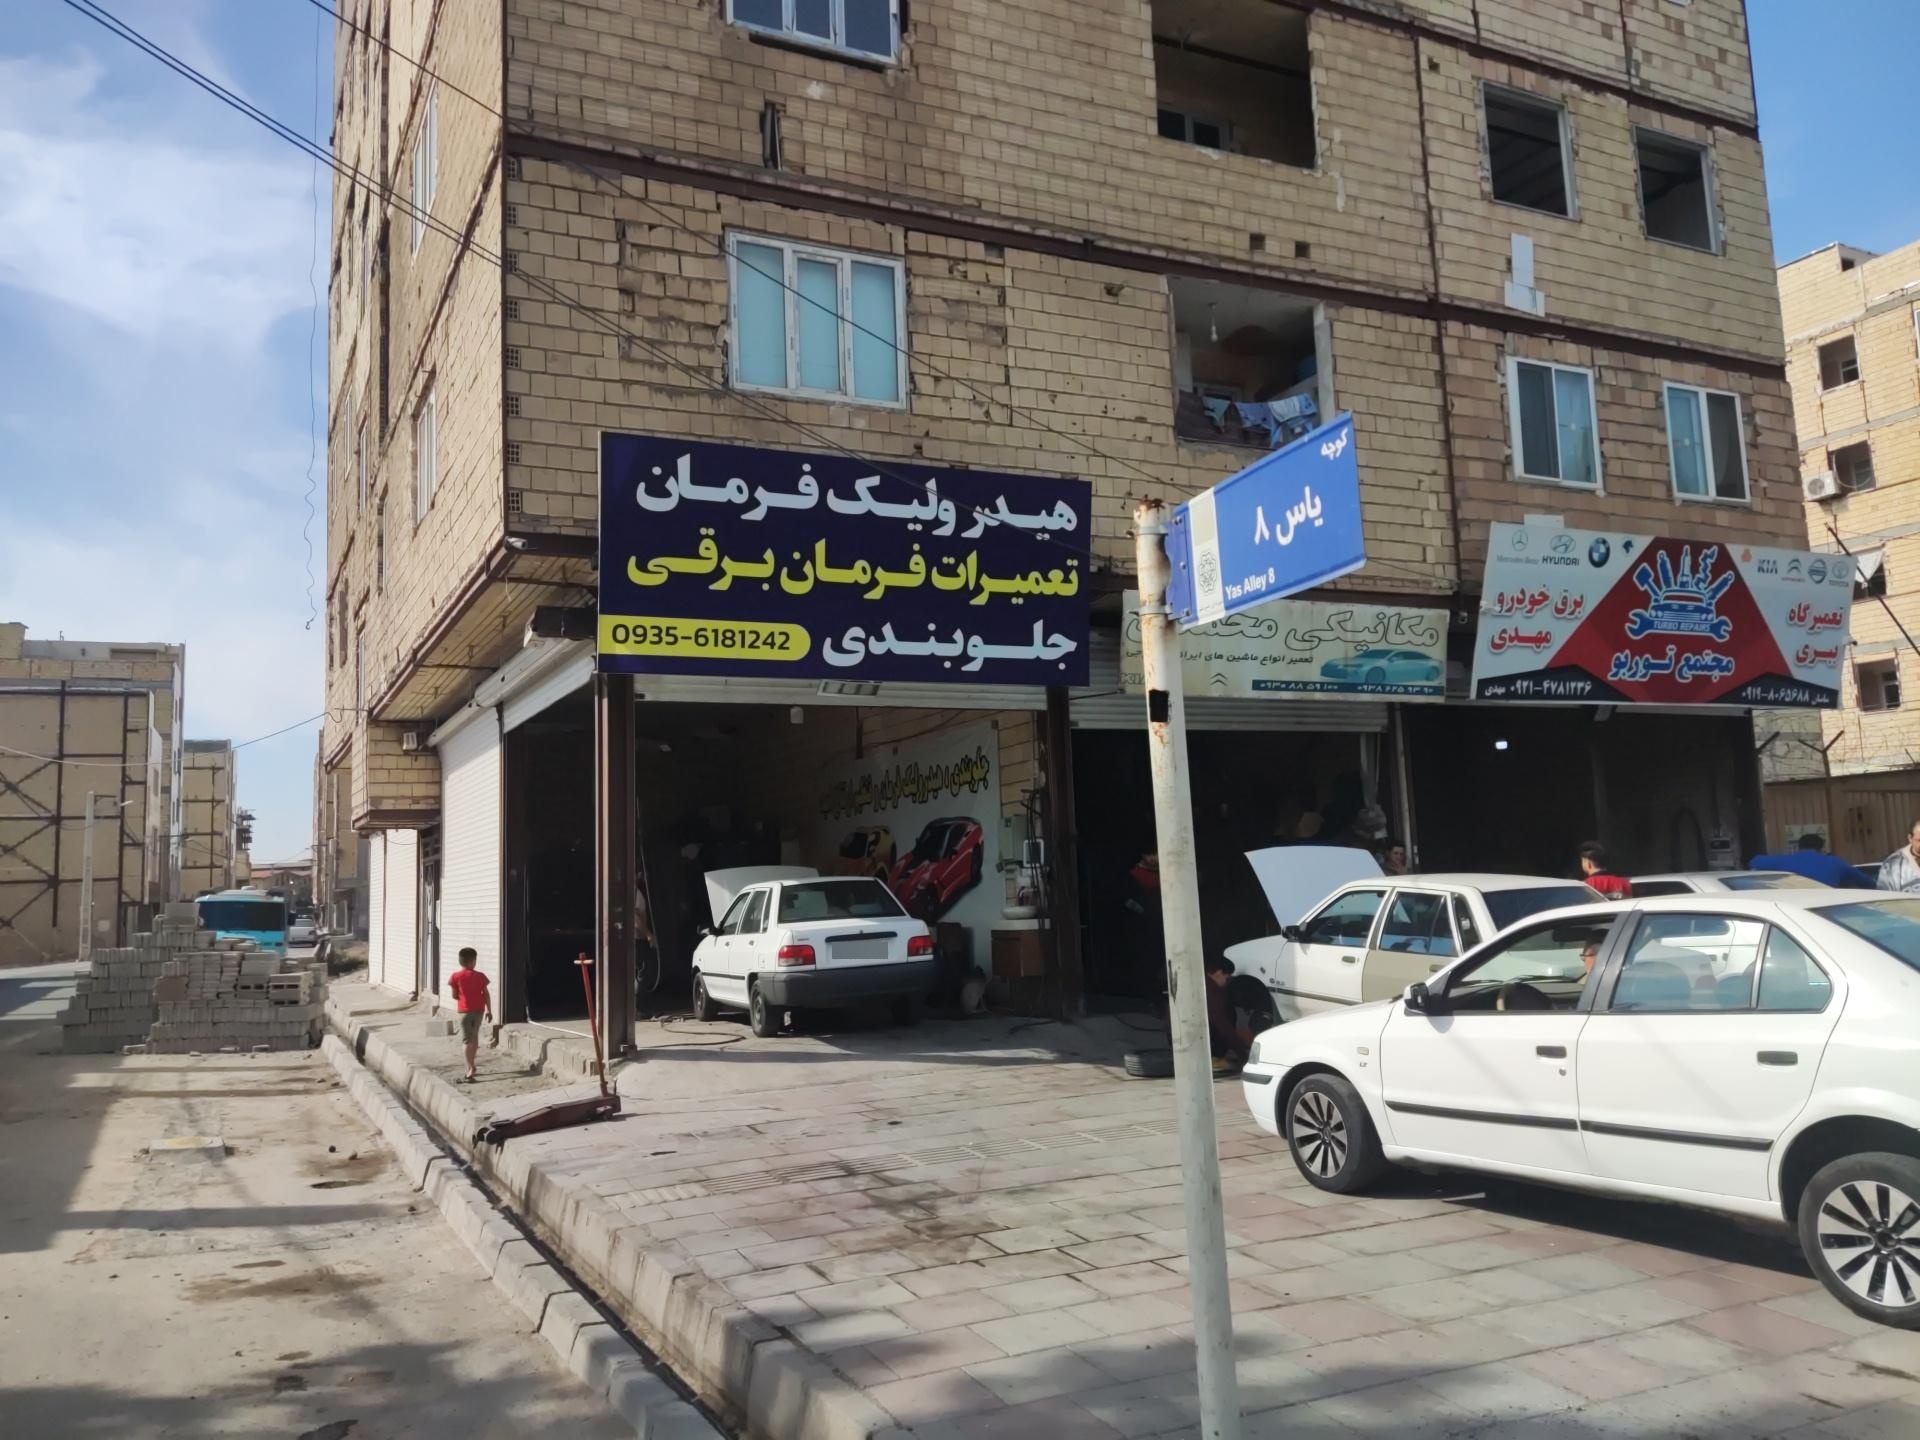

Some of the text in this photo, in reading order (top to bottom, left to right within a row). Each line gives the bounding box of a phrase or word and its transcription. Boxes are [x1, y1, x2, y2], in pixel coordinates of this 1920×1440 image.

[1321, 427, 1348, 460] کوچه
[636, 454, 820, 520] فرمان
[1254, 486, 1323, 546] یاس ۸
[627, 527, 1079, 605] تعمیرات فرمان برقی
[1542, 555, 1580, 566] HYUNDAI
[1757, 559, 1778, 574] KIA
[1225, 567, 1276, 600] Yas Alley 8
[1496, 584, 1584, 616] برق خودرو
[611, 623, 791, 651] 0935-6181242
[1285, 611, 1439, 652] مکانیکی
[1490, 626, 1552, 652] مهدی
[1653, 621, 1711, 633] TURBO REPAIRS
[822, 619, 1077, 672] جلوبندی
[1204, 653, 1224, 662] های
[1226, 653, 1259, 663] ماشین
[1289, 655, 1313, 664] تعمیر
[1260, 655, 1285, 666] انواع
[1608, 645, 1734, 683] مجتمع توربو
[1485, 685, 1506, 696] مهدی
